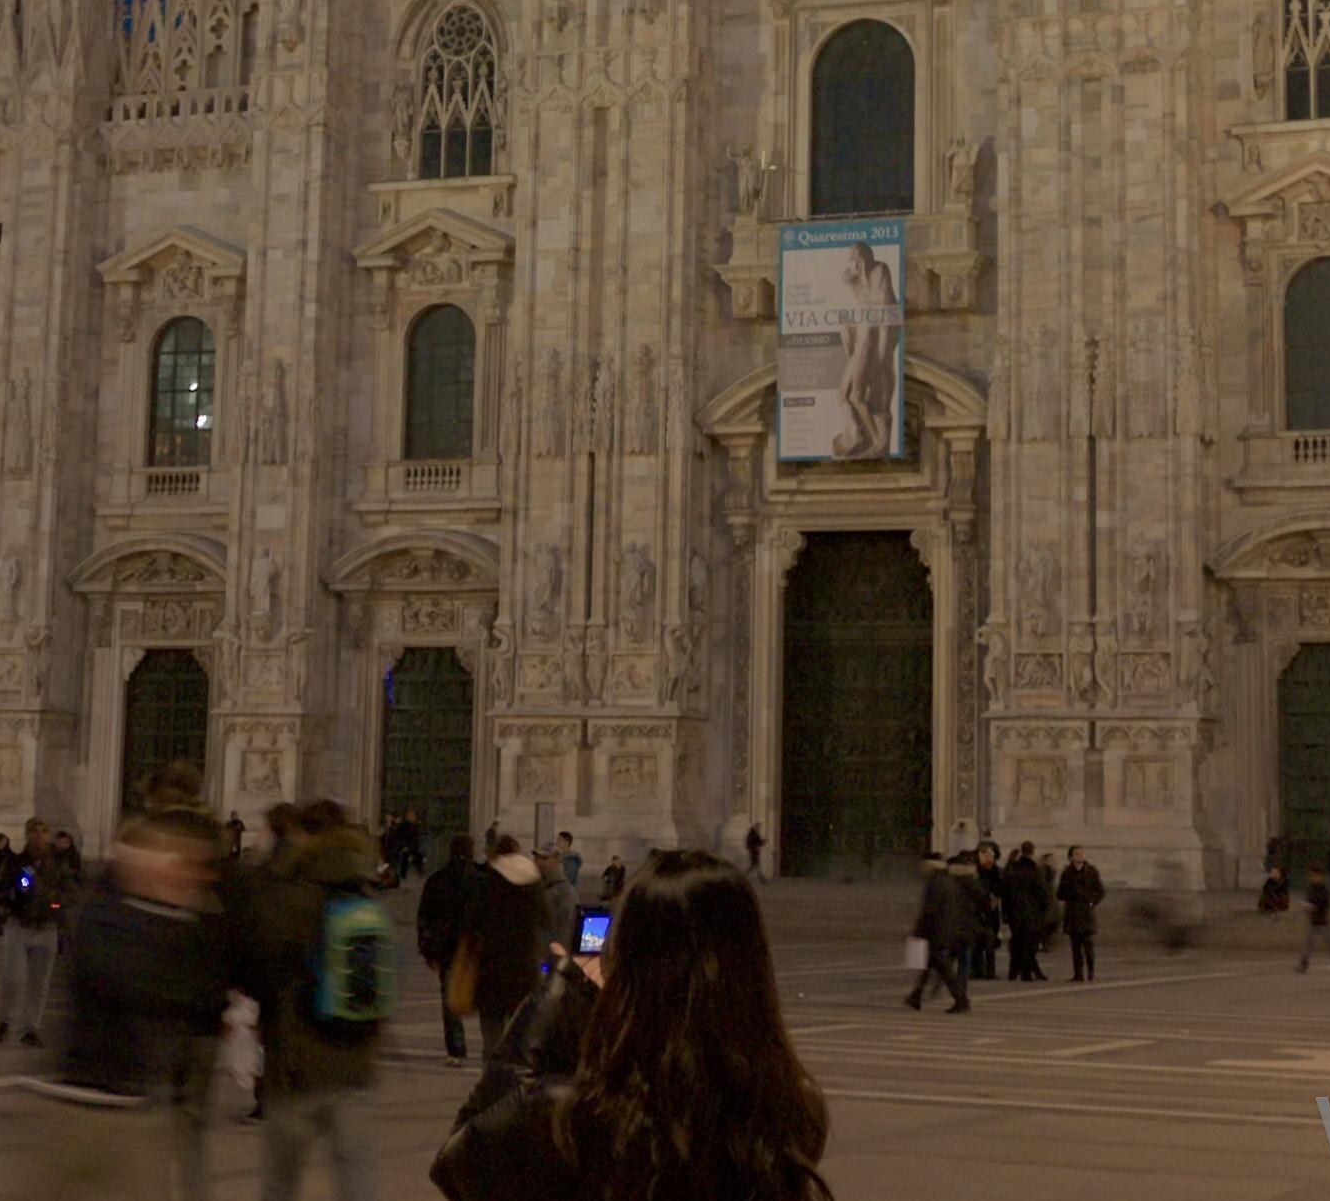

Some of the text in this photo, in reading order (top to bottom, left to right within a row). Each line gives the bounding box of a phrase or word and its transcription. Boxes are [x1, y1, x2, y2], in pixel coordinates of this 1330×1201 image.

[798, 226, 899, 246] Quaresima 2013
[785, 307, 899, 327] VIA CRUCIS
